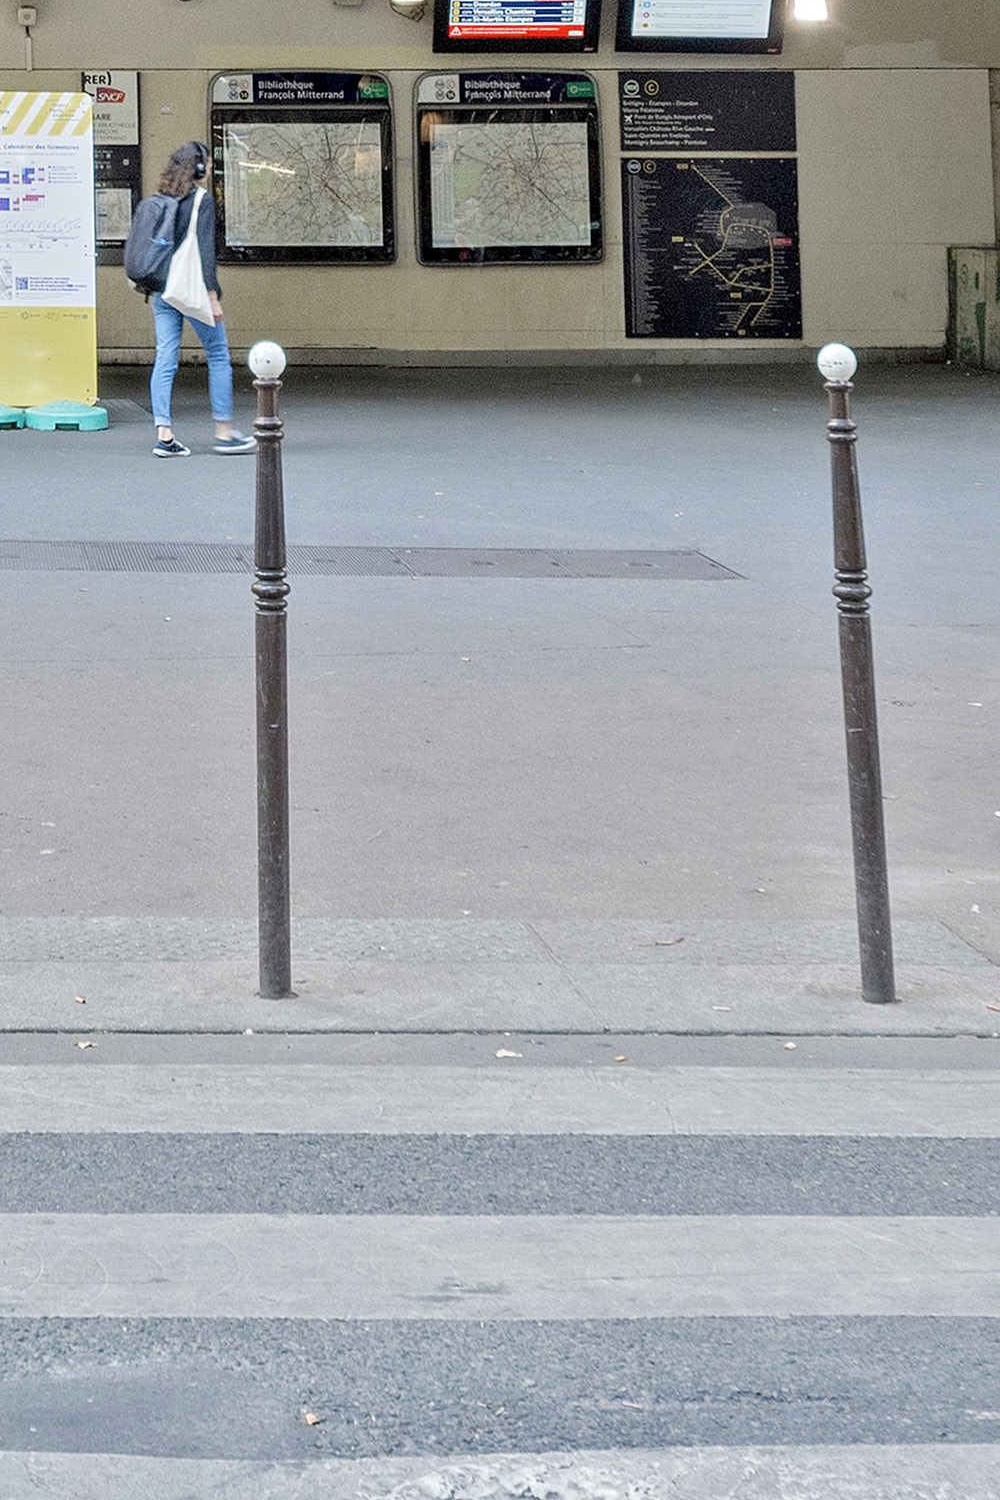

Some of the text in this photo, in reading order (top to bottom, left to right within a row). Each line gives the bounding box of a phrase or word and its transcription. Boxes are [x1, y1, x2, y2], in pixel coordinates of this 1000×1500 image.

[258, 80, 314, 90] Bibliothèque
[464, 80, 521, 90] Bibliothèque
[98, 92, 123, 102] SNCF
[258, 89, 345, 101] François Mitterrand
[464, 90, 552, 101] François Mitterrand
[93, 113, 111, 121] ARE
